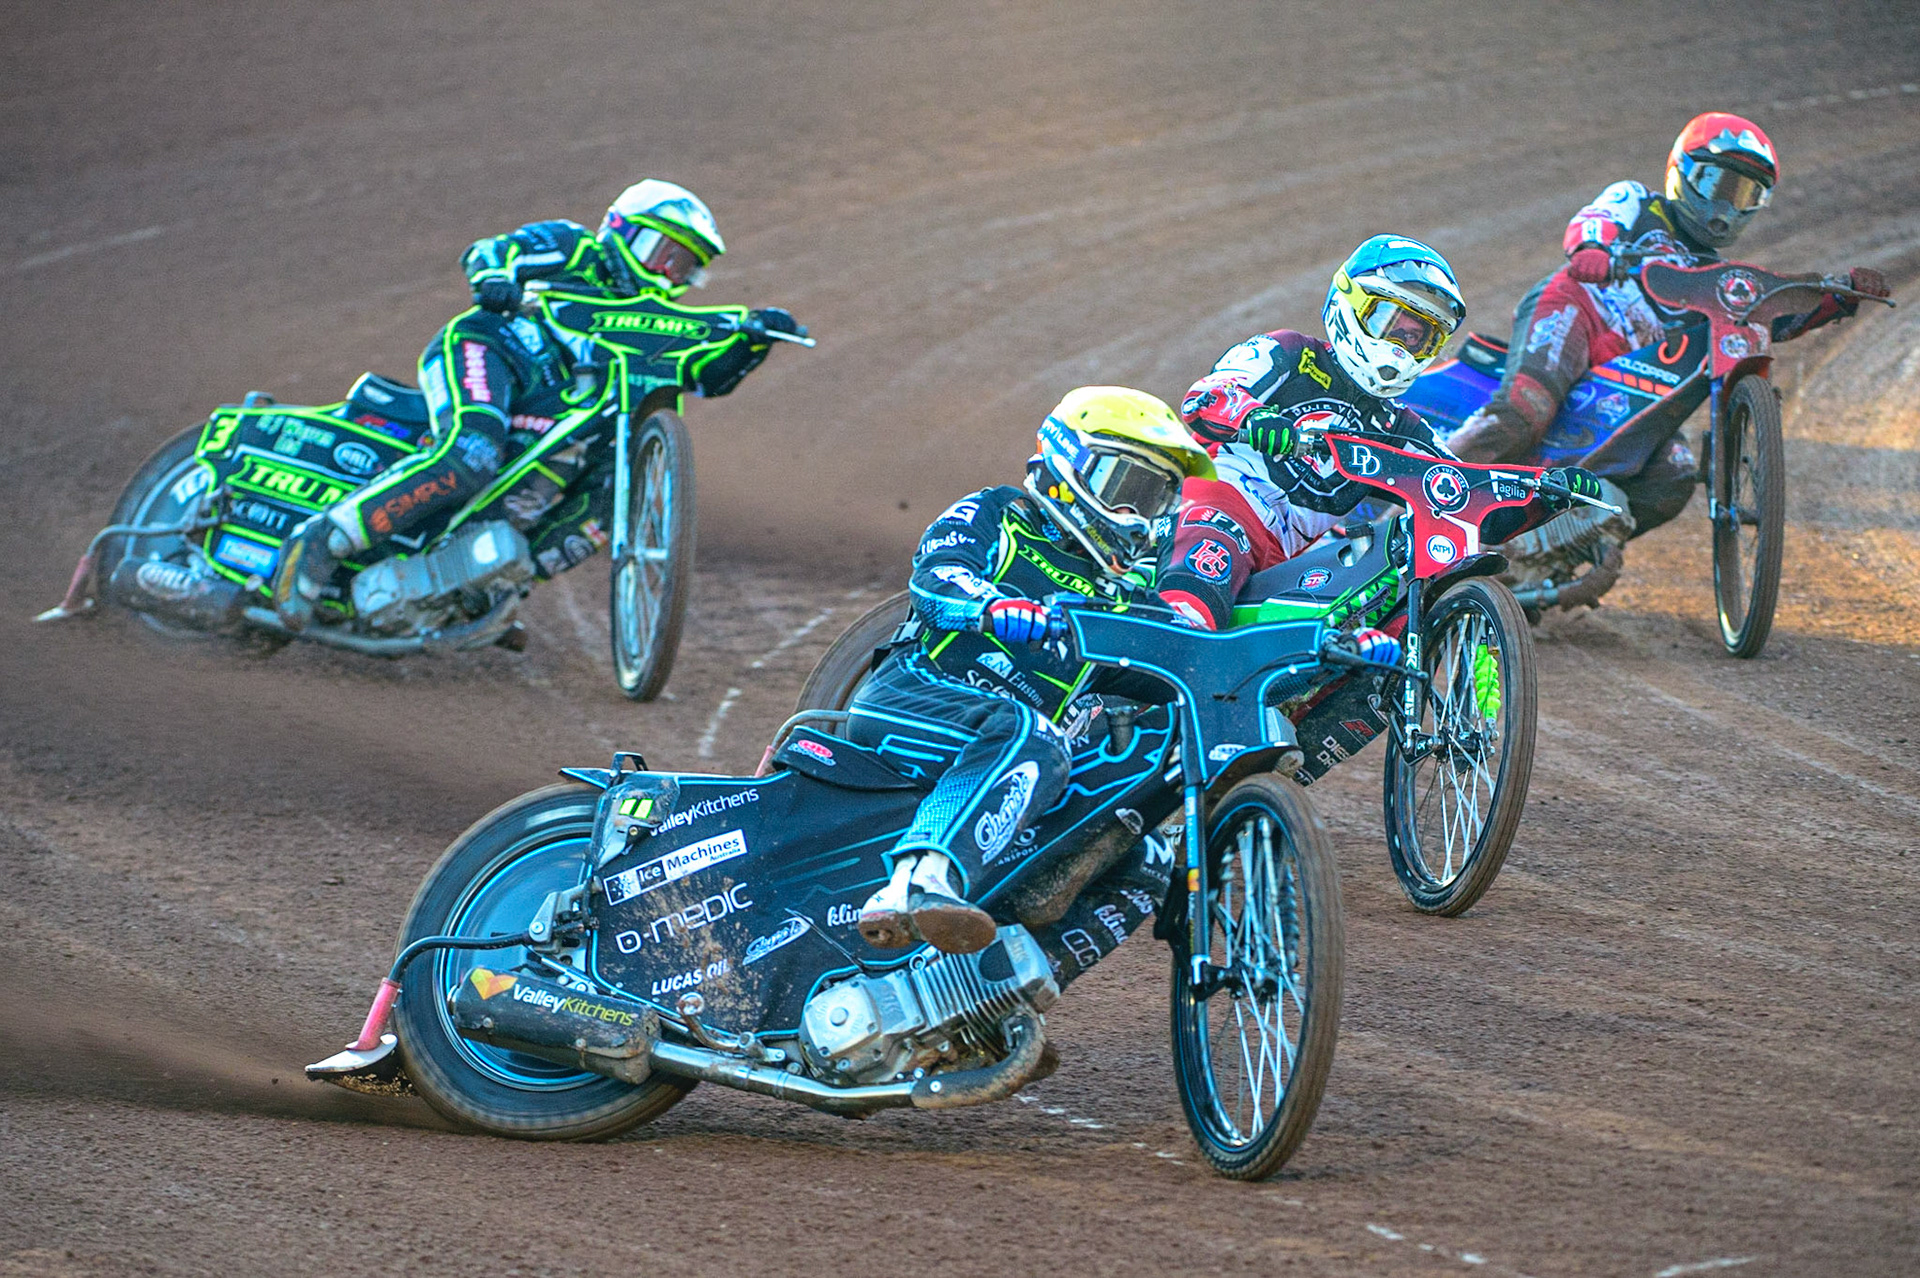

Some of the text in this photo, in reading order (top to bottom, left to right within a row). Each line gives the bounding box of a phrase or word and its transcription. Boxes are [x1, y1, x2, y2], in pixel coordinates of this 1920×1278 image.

[204, 416, 240, 452] 3
[1425, 466, 1468, 489] BELLE VUE ACES
[1432, 544, 1451, 554] ATPI
[650, 787, 760, 837] alleyKitchens
[638, 837, 740, 883] Ice Machines
[651, 958, 731, 996] LUCAS OIL
[512, 982, 635, 1027] ValleyKitchens
